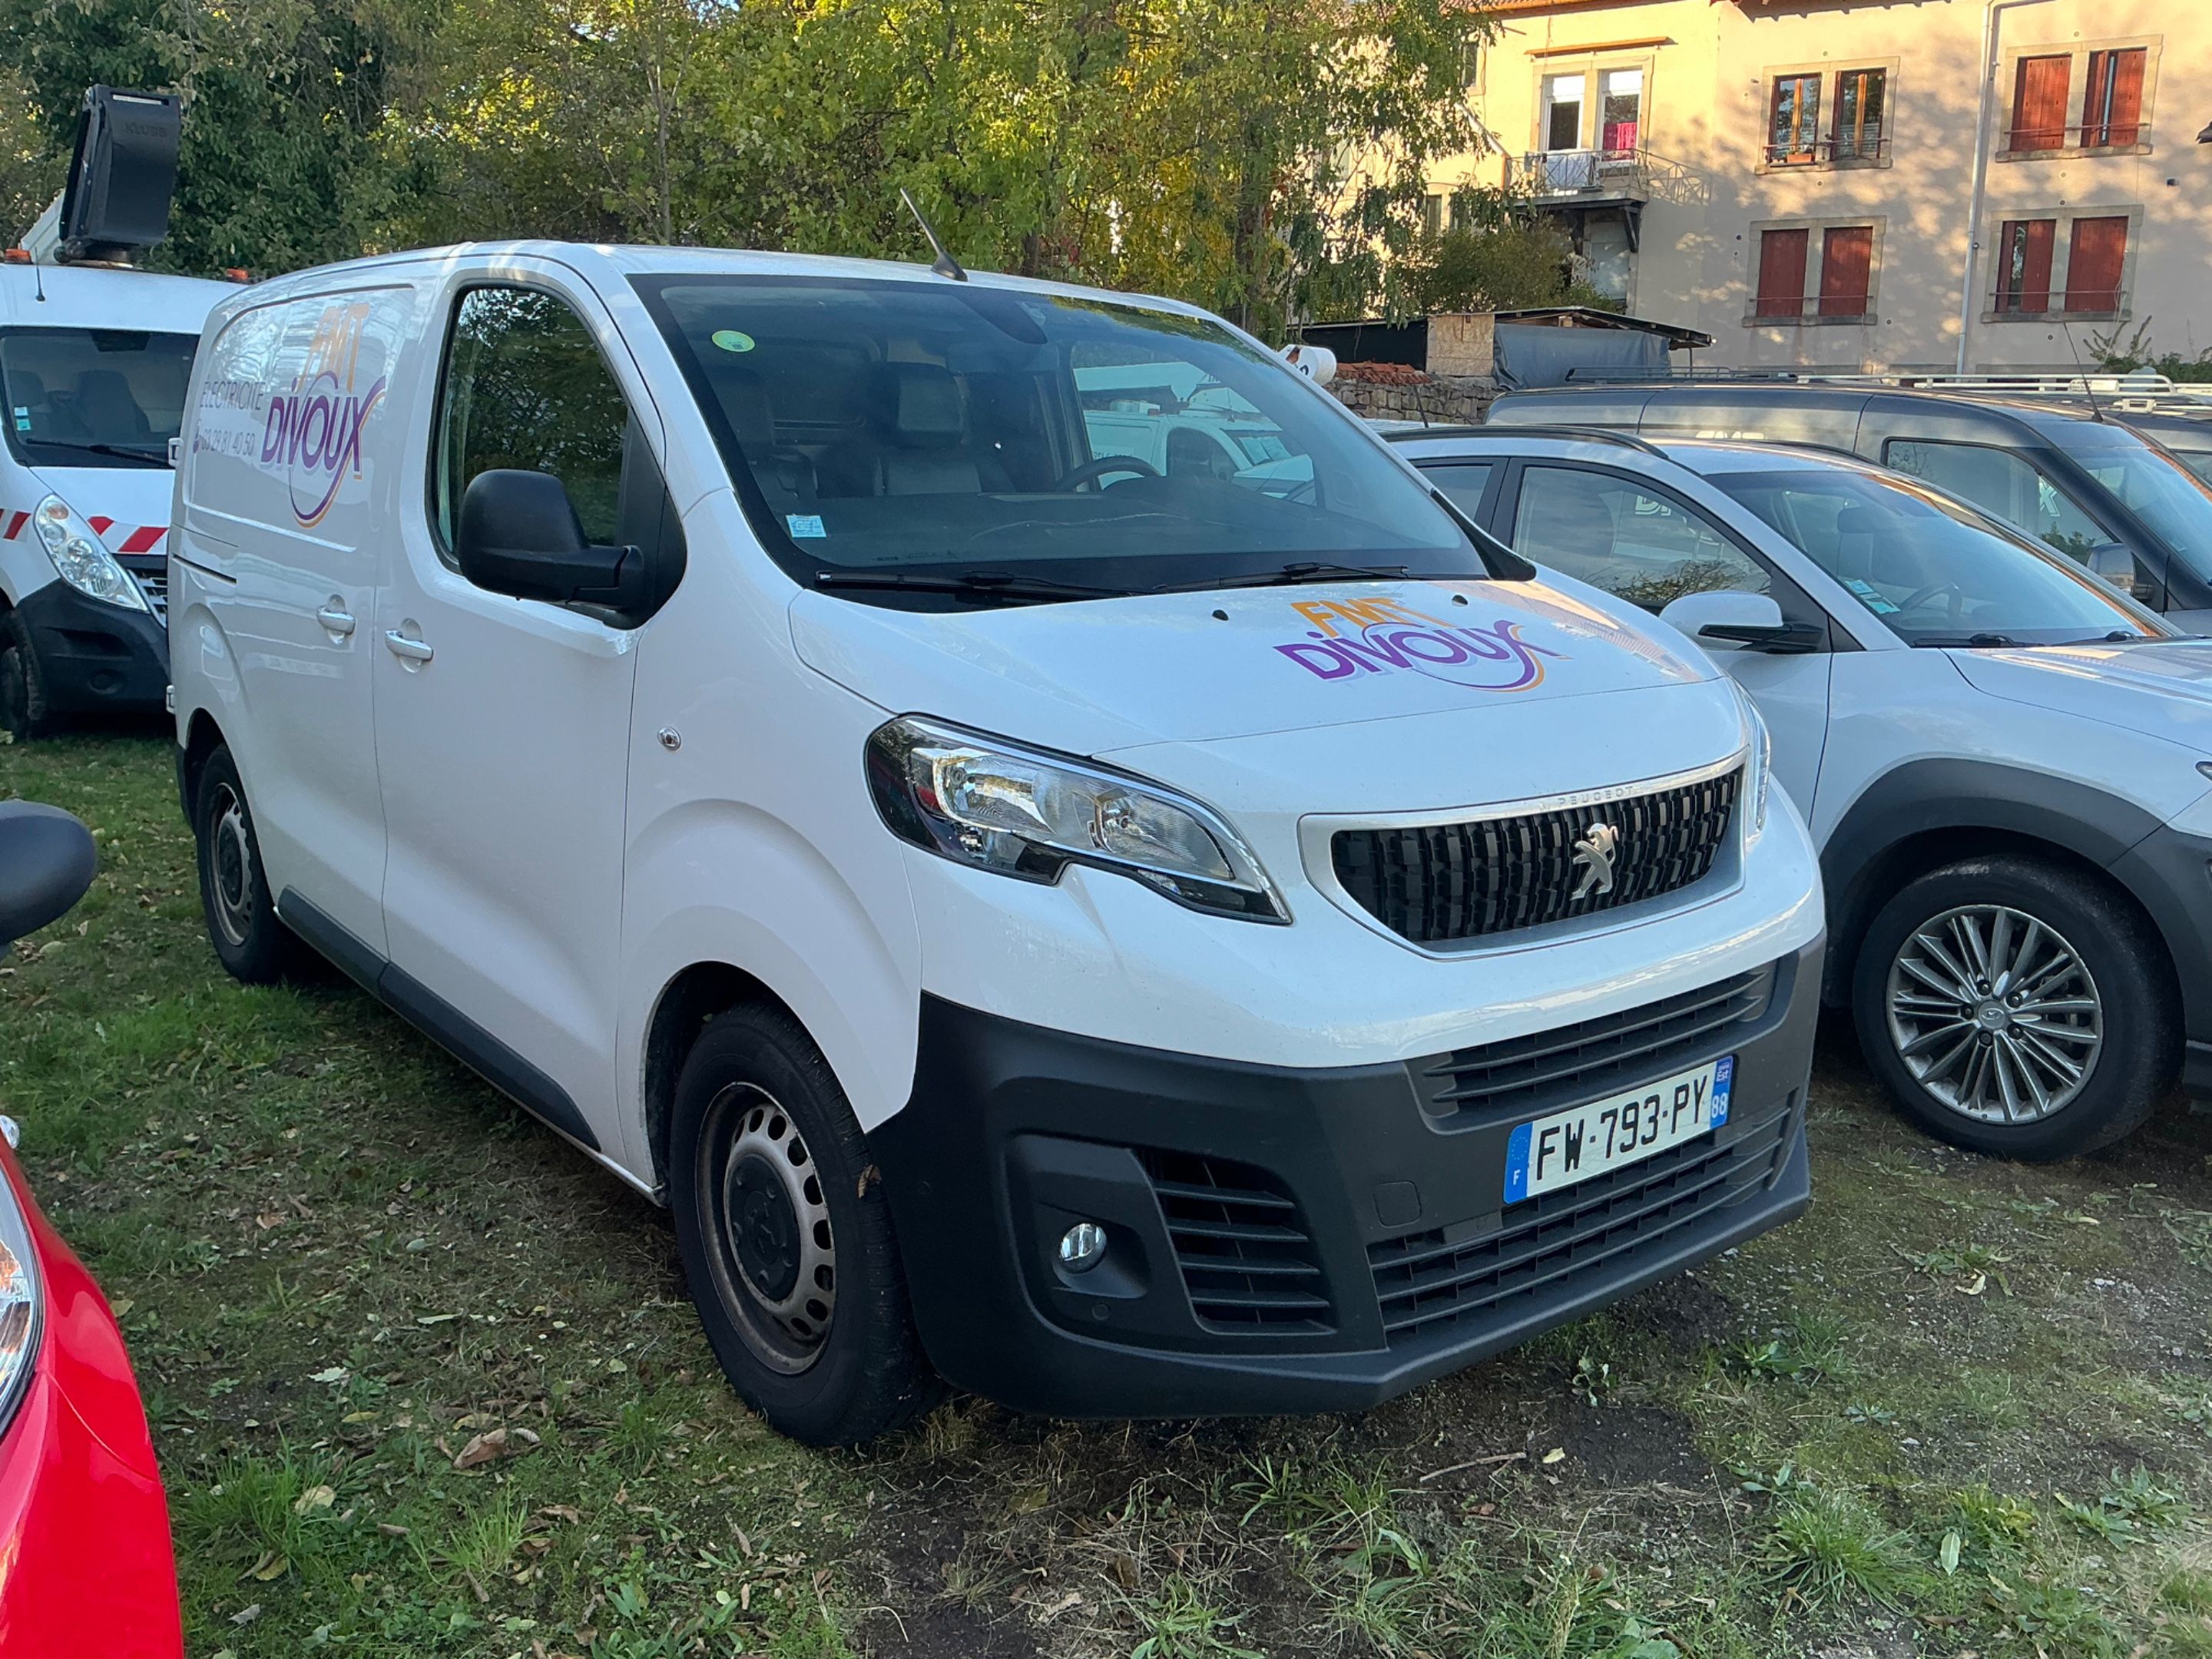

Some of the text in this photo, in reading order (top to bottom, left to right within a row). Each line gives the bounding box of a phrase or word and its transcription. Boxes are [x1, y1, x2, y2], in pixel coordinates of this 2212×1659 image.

[296, 303, 369, 394] FMT
[1290, 597, 1459, 637] FMT
[1558, 785, 1634, 806] PEUGEOT
[1711, 1092, 1729, 1119] 88
[1513, 1169, 1521, 1186] F
